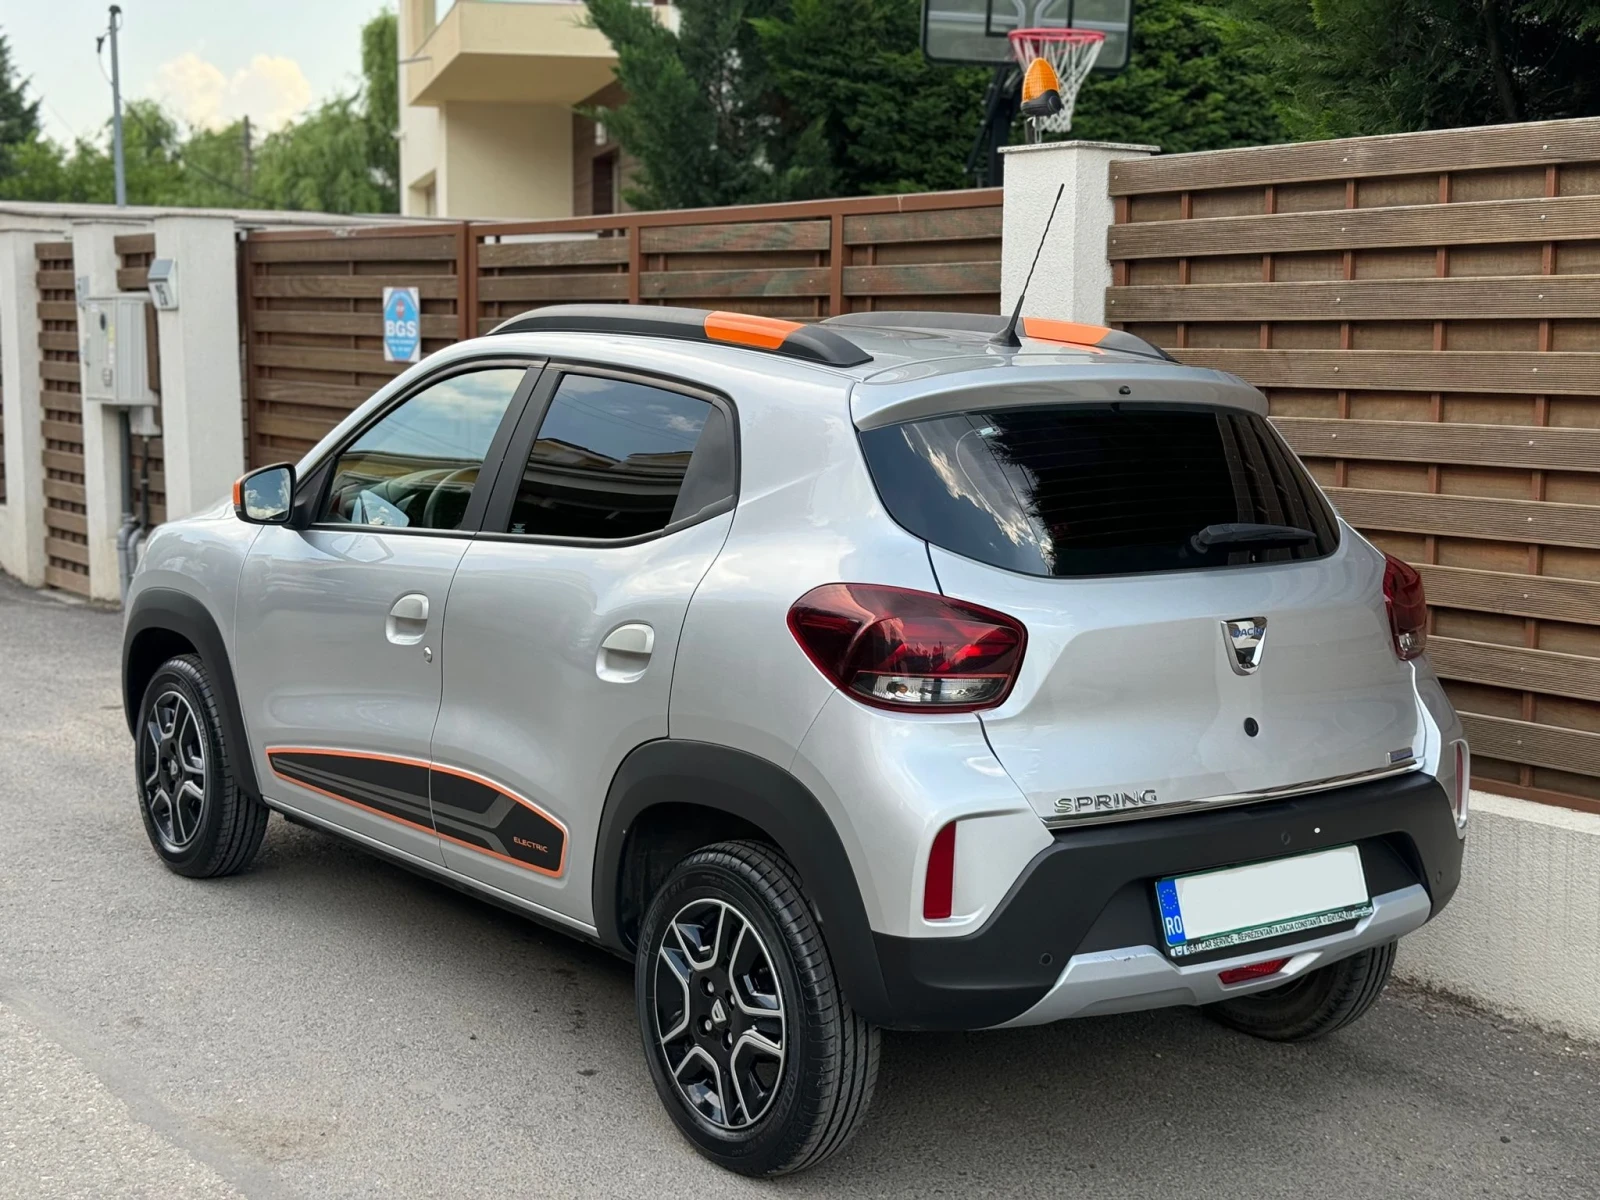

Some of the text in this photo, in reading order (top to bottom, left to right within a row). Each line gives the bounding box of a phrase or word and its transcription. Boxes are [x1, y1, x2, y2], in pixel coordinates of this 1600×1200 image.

[385, 320, 417, 337] BGS
[1054, 789, 1157, 813] SPRING
[513, 836, 548, 853] ELECTRIC
[1165, 915, 1183, 936] RO
[1213, 936, 1234, 947] SERVICE
[1280, 922, 1294, 933] DACIA
